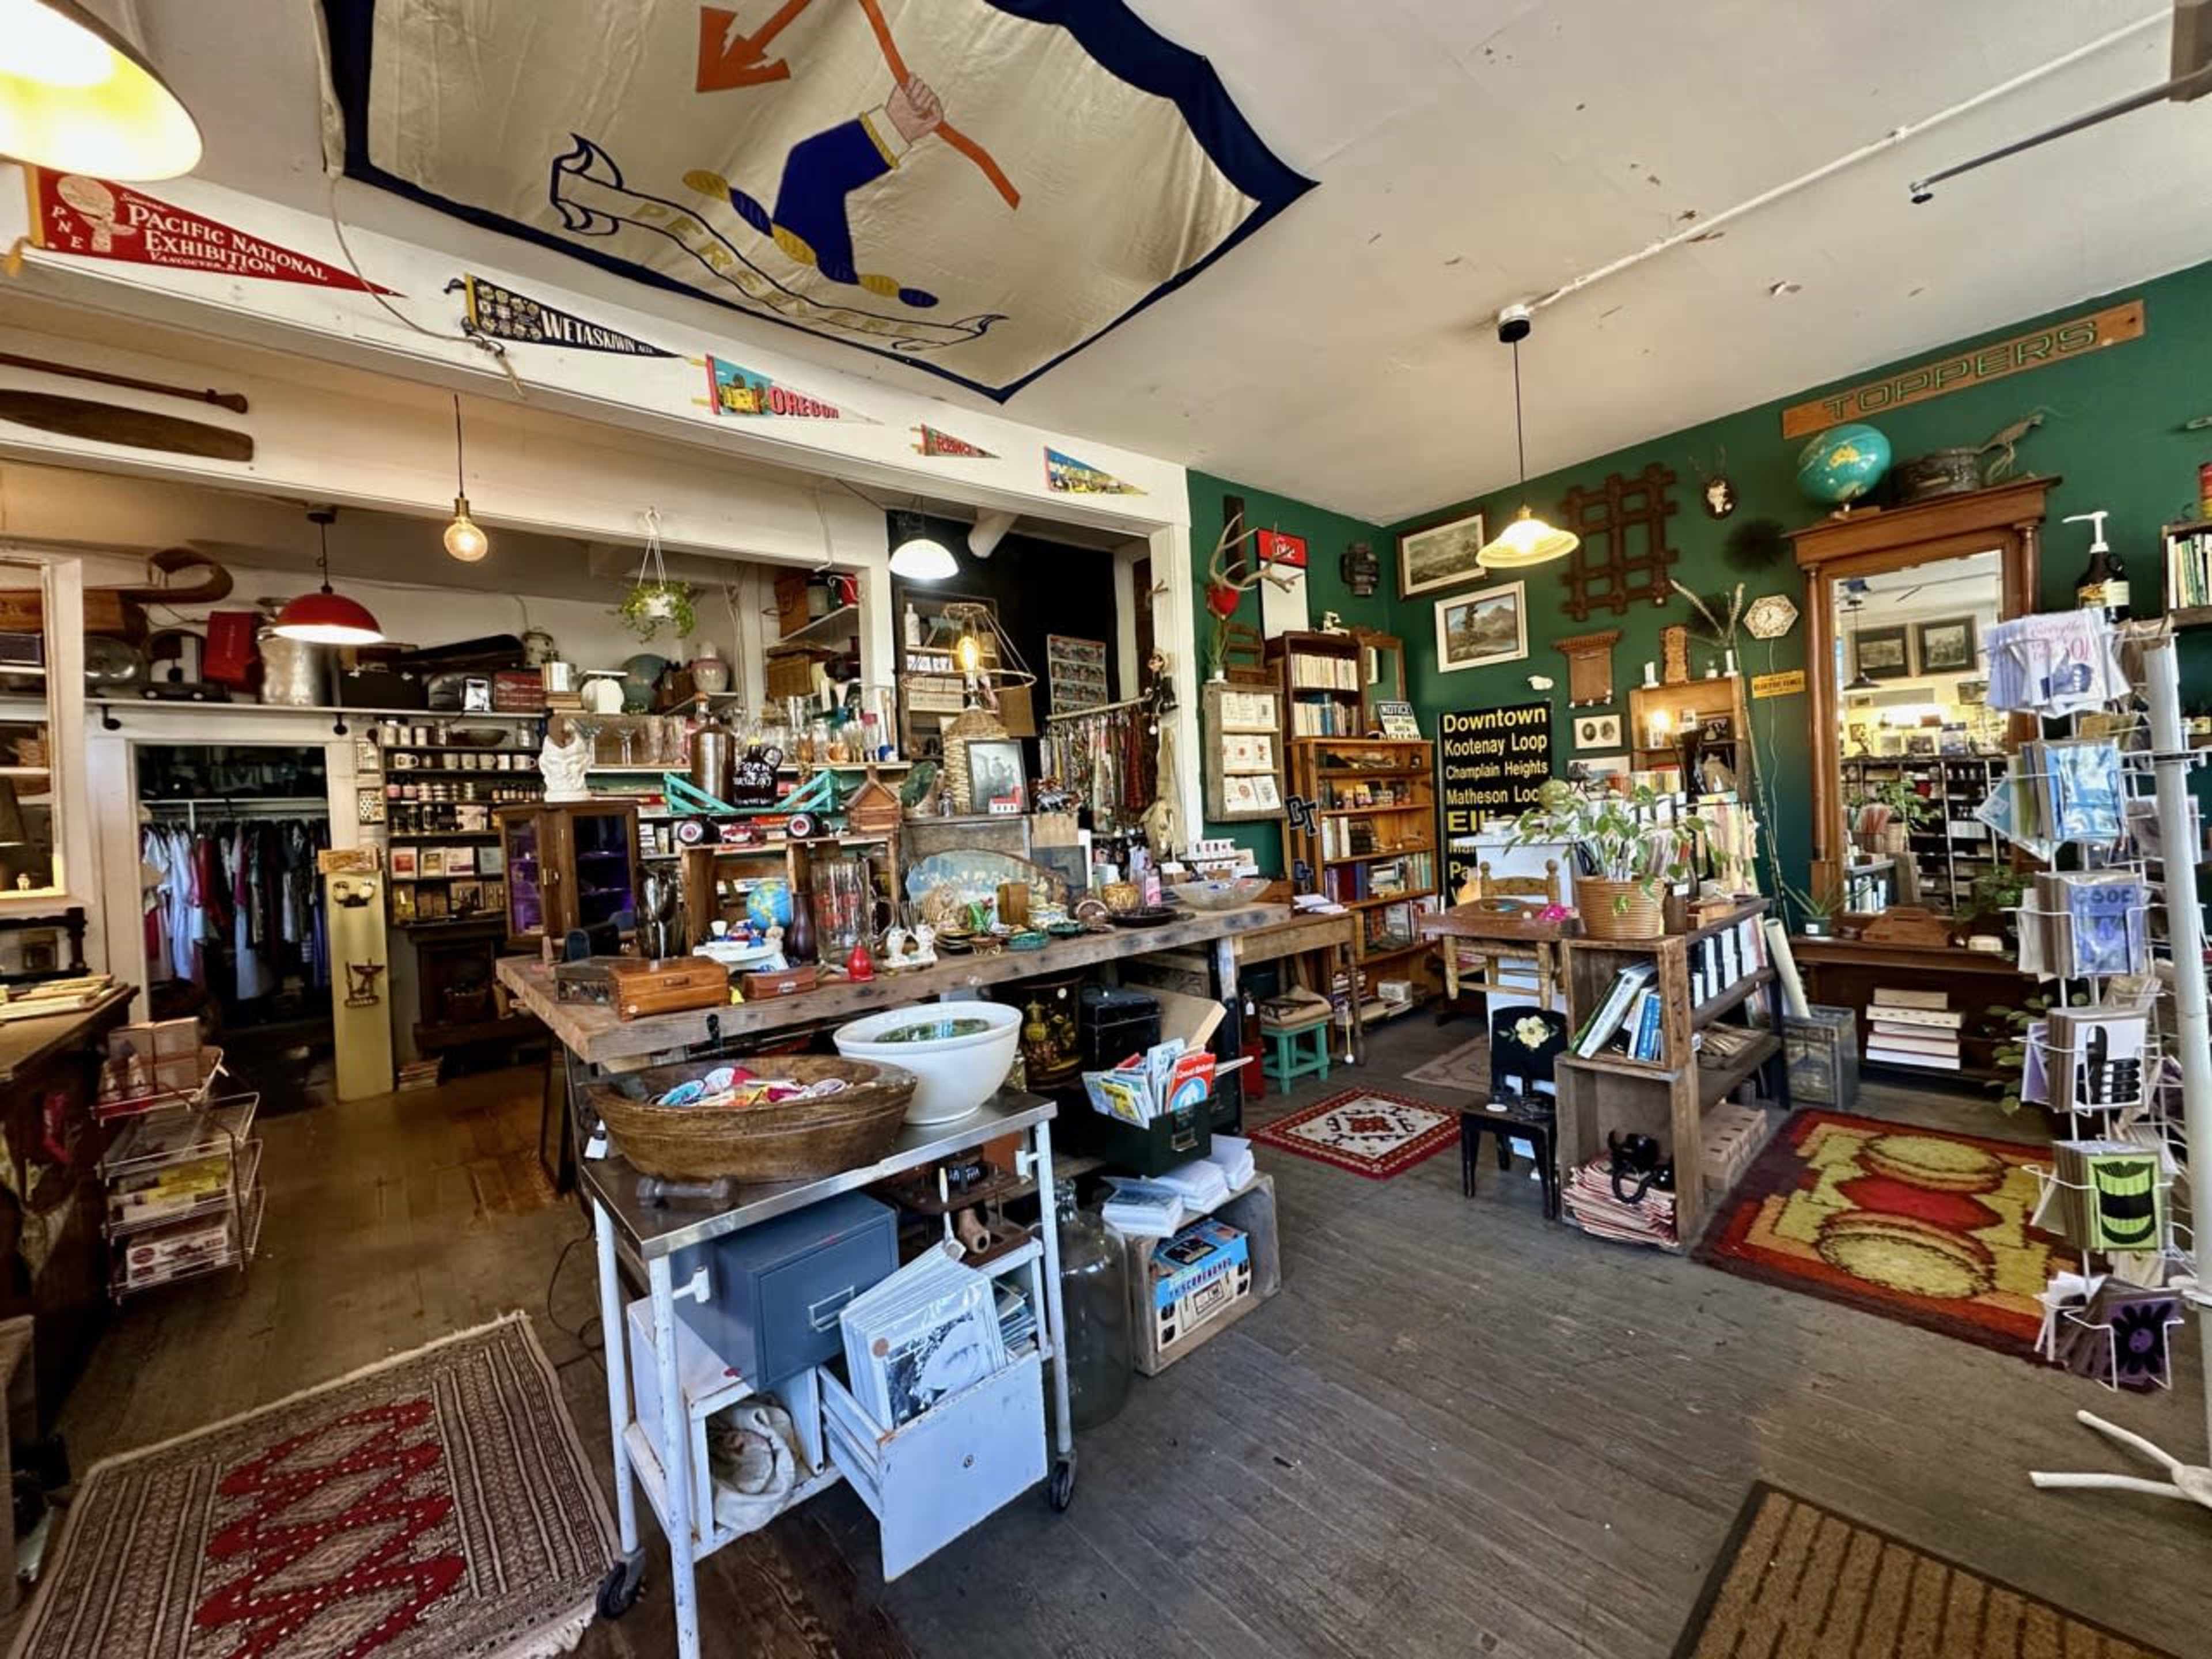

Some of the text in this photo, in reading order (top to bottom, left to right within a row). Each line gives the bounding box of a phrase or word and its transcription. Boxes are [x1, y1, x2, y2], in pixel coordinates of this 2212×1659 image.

[127, 203, 328, 281] PACIFIC NATIONAL
[145, 230, 276, 274] EXHIBITION
[540, 309, 635, 353] WETASKIWIN
[1824, 319, 2097, 420] TOPPERS
[768, 386, 839, 419] OREGON
[1443, 707, 1546, 733] Downtown
[1444, 732, 1547, 757] Kootenay Loop
[1446, 760, 1548, 781] Champlain Heights
[1446, 786, 1539, 805] Matheson Loo
